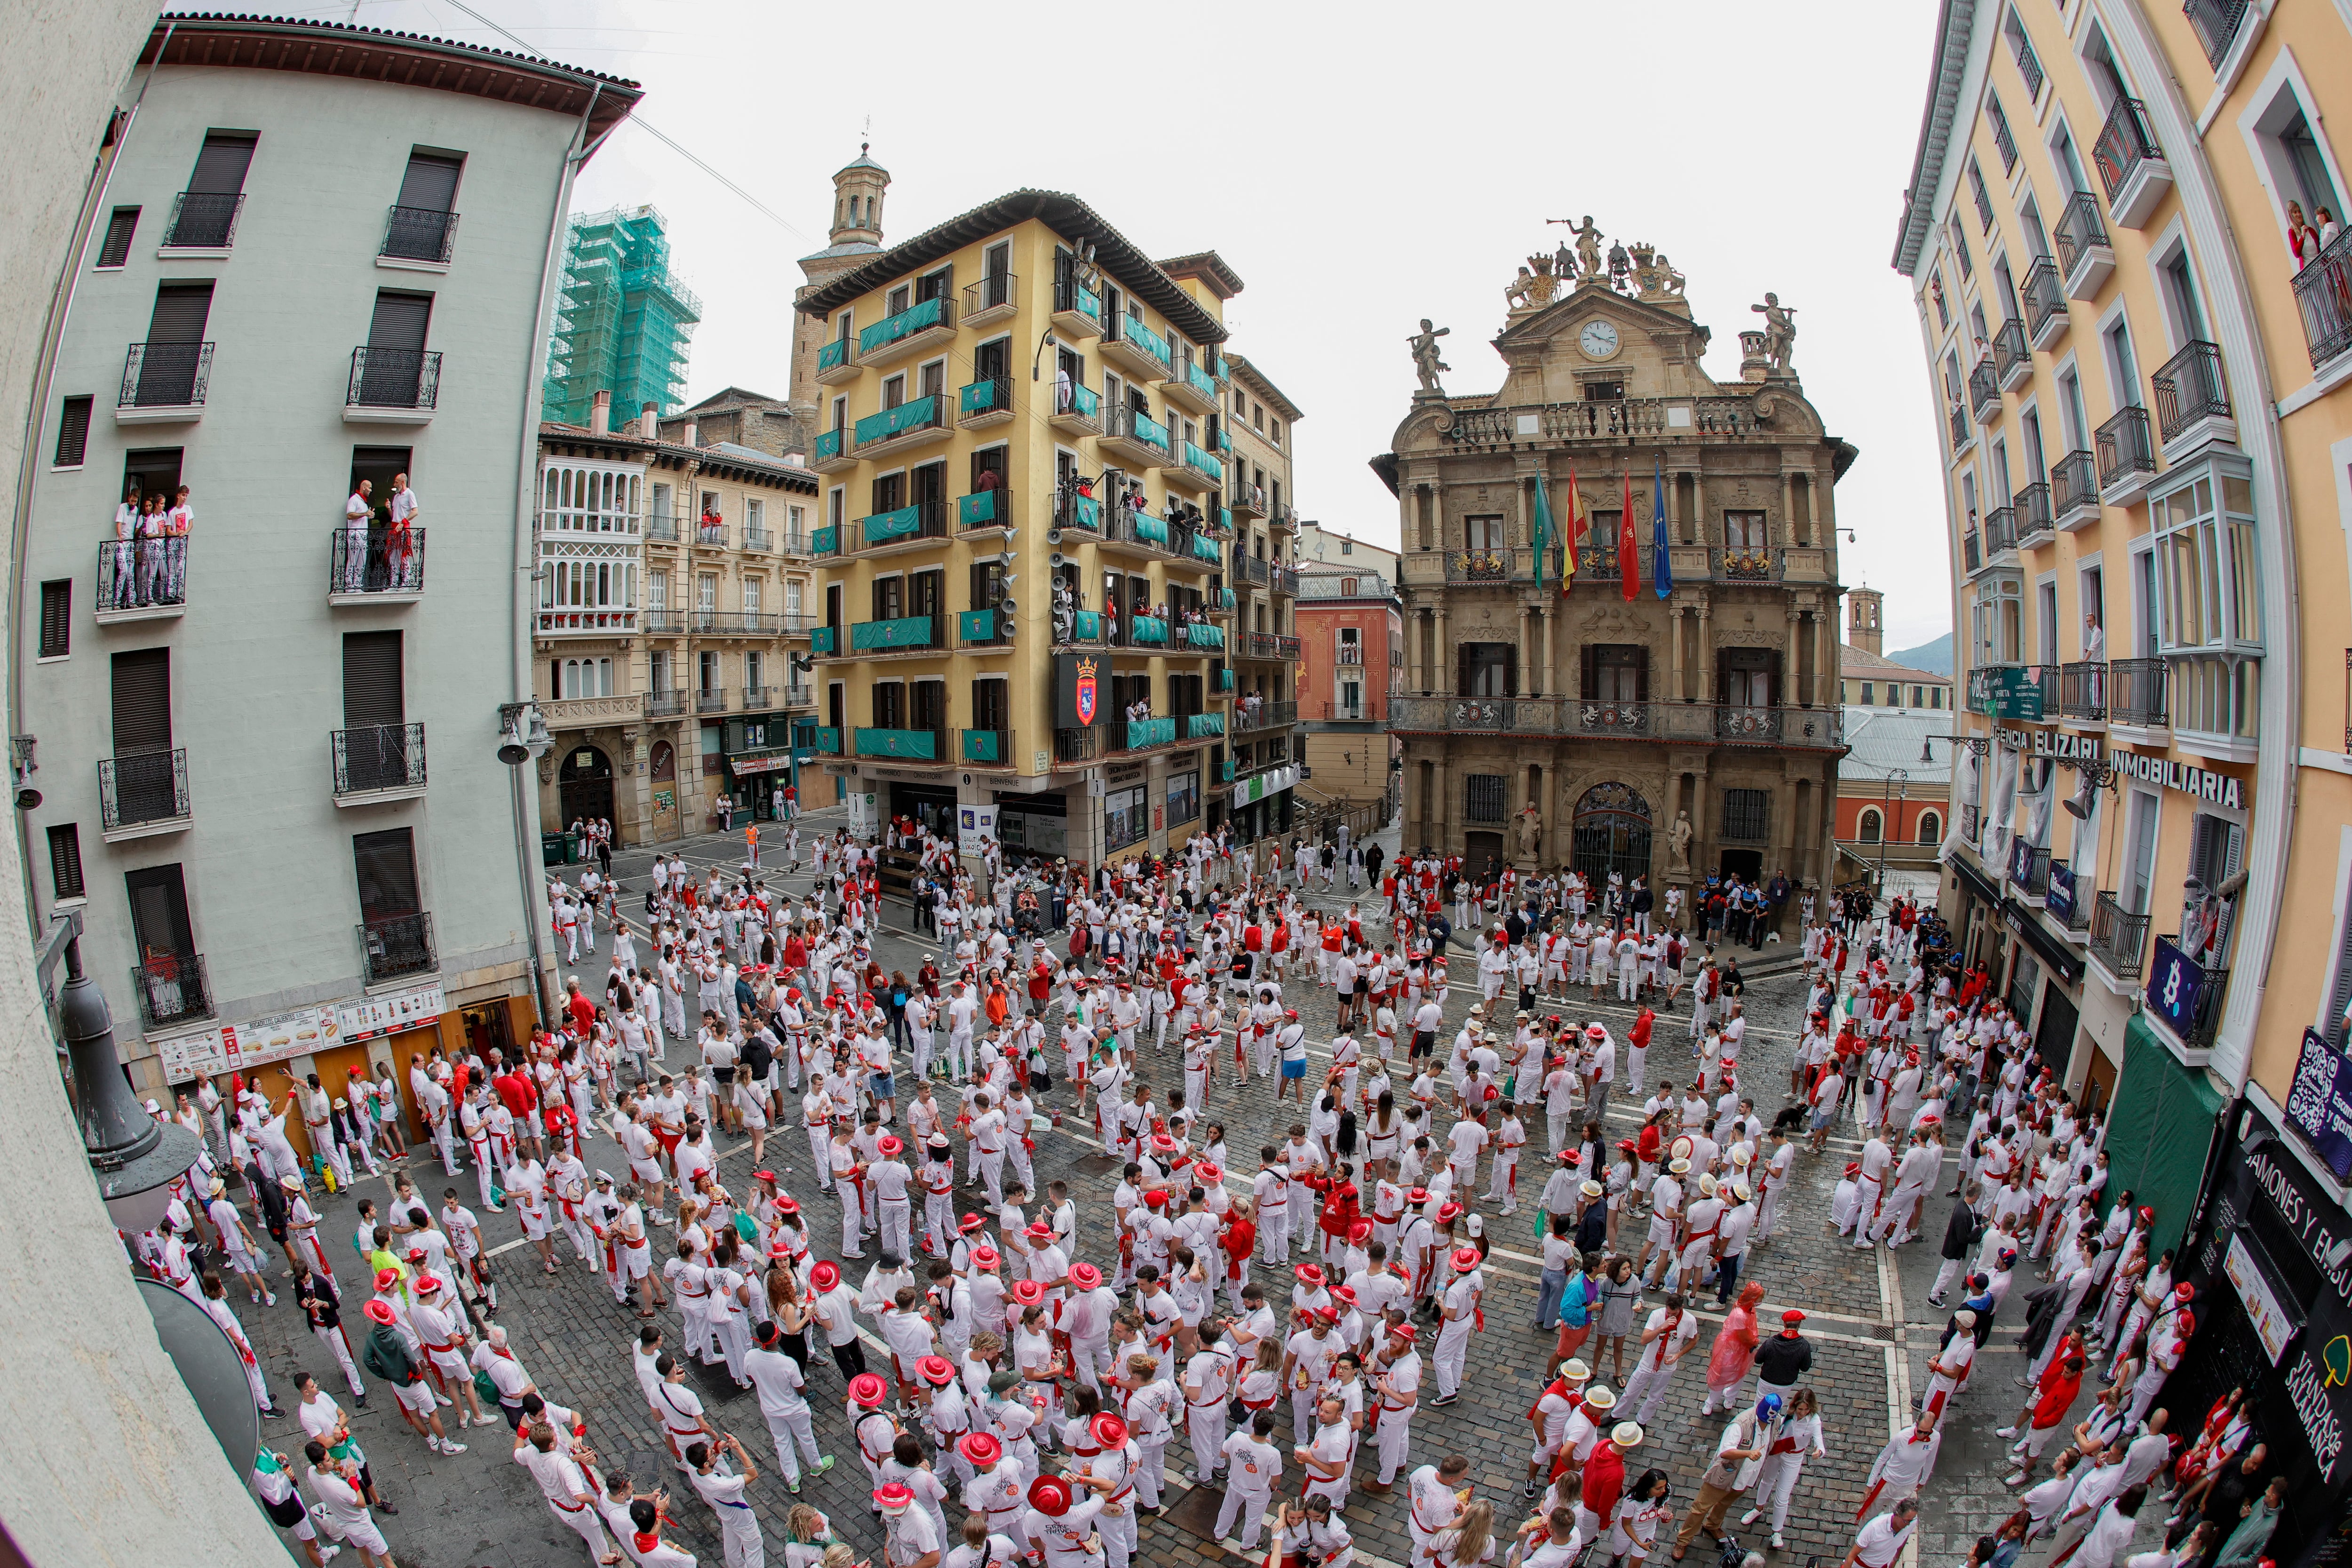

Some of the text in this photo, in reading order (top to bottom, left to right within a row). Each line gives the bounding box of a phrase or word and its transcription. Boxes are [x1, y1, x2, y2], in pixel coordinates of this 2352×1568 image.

[1990, 725, 2099, 759] AGENCIA ELIZARI
[658, 748, 671, 767] INFANTIL
[990, 778, 1019, 787] BIENVENUE
[2110, 748, 2241, 810] INMOBILIARIA
[2006, 912, 2015, 927] BAR
[360, 996, 375, 1006] FRÍAS
[249, 1017, 274, 1029] BOCADILLOS
[275, 1013, 295, 1023] CALIENTES
[250, 1054, 275, 1064] TRADITIONAL
[284, 1045, 310, 1058] SANDWICHES
[2326, 1109, 2333, 1123] y
[2245, 1153, 2304, 1224] JAMONES
[2302, 1209, 2318, 1239] Y
[2297, 1350, 2343, 1457] VIANDAS de
[2285, 1367, 2337, 1484] SALAMANCA
[1235, 1451, 1255, 1465] TRAVEL
[1238, 1449, 1256, 1460] STOKE
